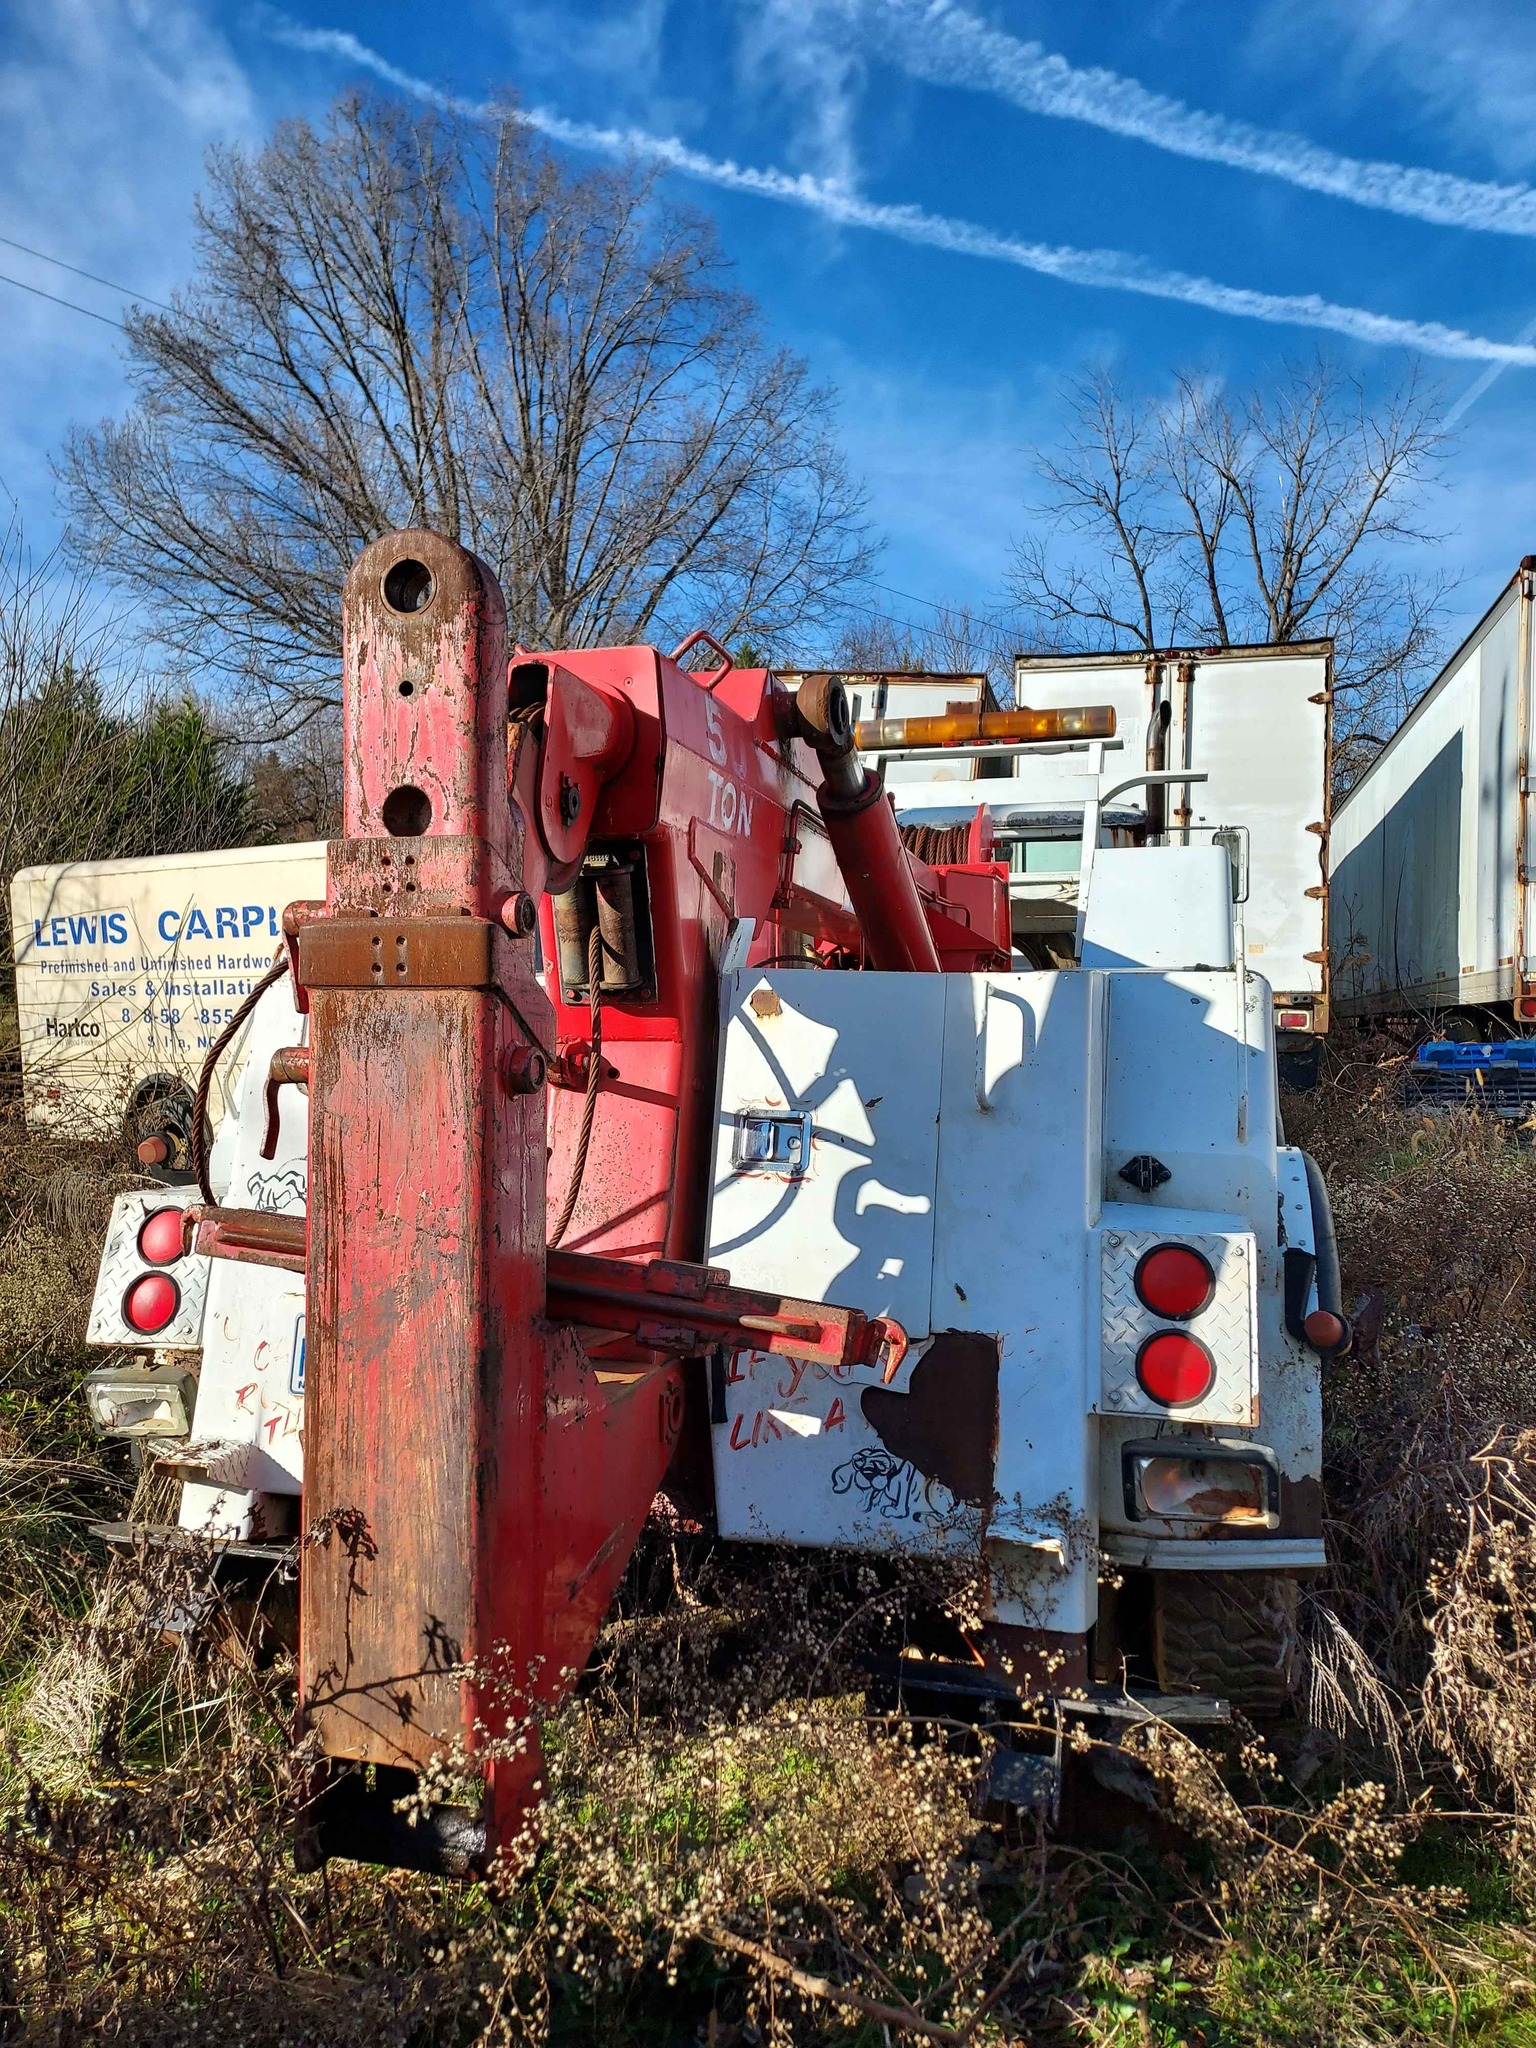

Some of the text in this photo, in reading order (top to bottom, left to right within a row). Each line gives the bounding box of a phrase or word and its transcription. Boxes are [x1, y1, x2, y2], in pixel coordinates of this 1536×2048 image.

[706, 769, 754, 839] TON
[34, 912, 128, 947] LEWIS
[40, 953, 272, 975] Prefinished and Unfinished Hardwo
[90, 978, 258, 997] Sales & Installati
[46, 1017, 101, 1038] Hartco
[822, 1396, 848, 1433] A
